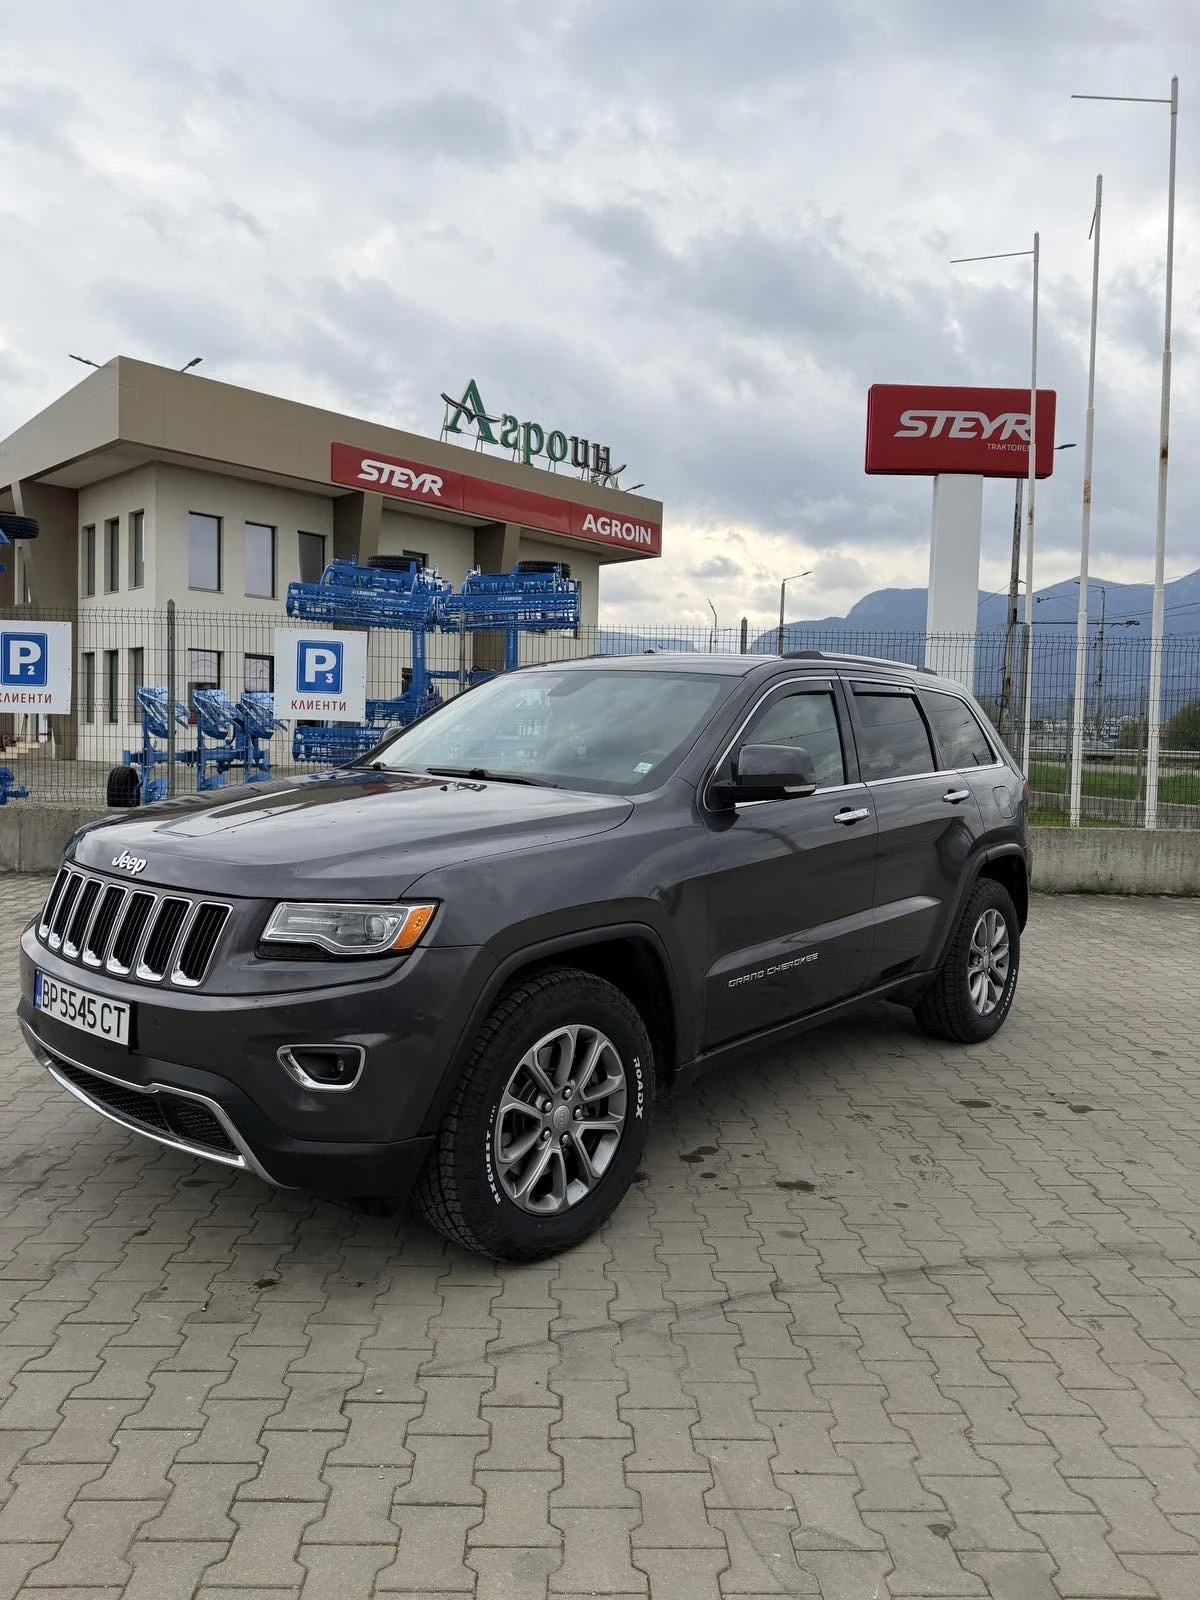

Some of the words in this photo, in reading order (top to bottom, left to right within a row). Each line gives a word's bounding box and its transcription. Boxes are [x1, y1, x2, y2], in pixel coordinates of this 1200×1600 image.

[894, 409, 1032, 441] STEYR
[357, 458, 443, 497] STEYR
[582, 513, 651, 545] AGROIN
[291, 699, 347, 712] КЛИЕНТИ
[111, 850, 147, 876] Jeep
[728, 970, 765, 988] GRAND
[766, 952, 819, 976] CHEROKEE
[632, 1056, 644, 1120] ROADX
